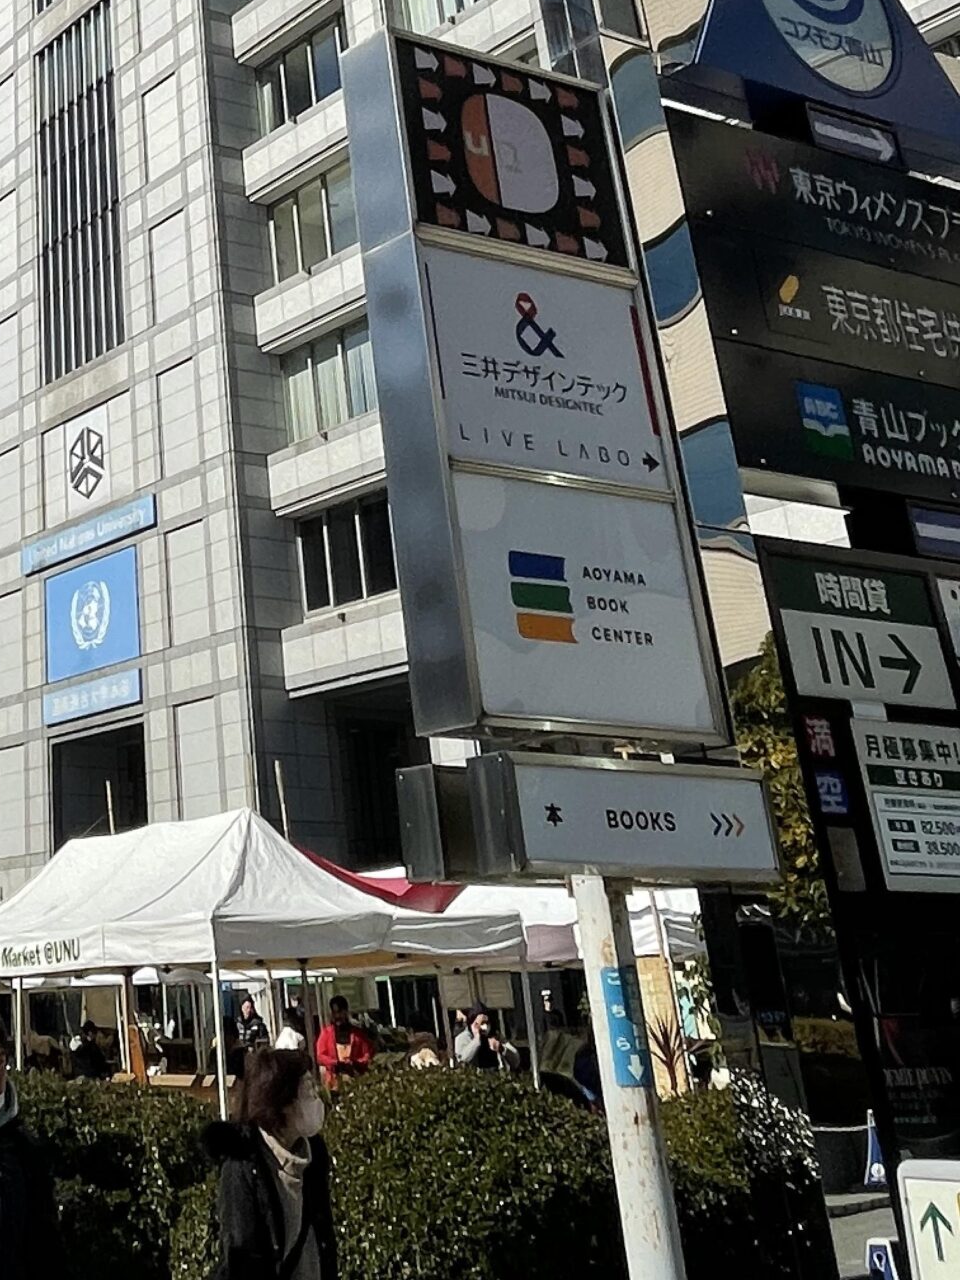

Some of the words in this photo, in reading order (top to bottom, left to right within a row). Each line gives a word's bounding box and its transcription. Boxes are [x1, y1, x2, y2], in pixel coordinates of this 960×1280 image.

[461, 352, 628, 404] 三井デザインテック
[494, 386, 537, 405] MITSUI
[540, 394, 604, 417] DESIGNTEC
[458, 423, 535, 451] LIVE
[557, 439, 630, 467] LABO
[581, 565, 647, 587] AOYAMA
[586, 595, 630, 614] BOOK
[814, 572, 891, 615] 時間貸
[591, 626, 654, 647] CENTER
[811, 626, 876, 689] IN
[605, 809, 677, 833] BOOKS
[1, 945, 41, 968] Market
[43, 937, 81, 964] @UNU
